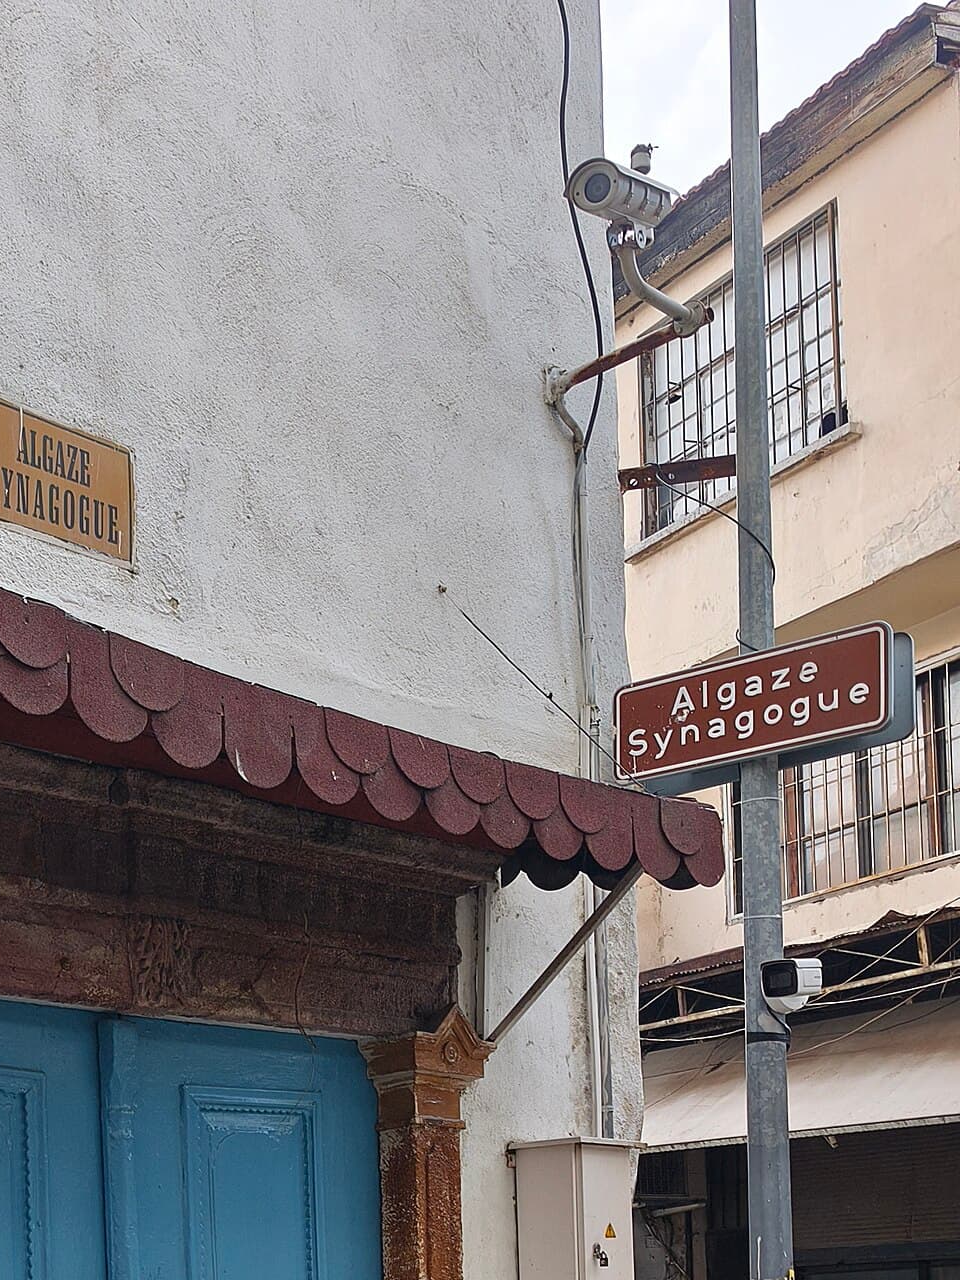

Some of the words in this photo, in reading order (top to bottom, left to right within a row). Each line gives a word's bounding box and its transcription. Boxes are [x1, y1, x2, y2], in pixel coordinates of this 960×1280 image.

[16, 426, 91, 488] ALGAZE
[671, 661, 818, 715] Algaze
[628, 682, 870, 759] Synagogue
